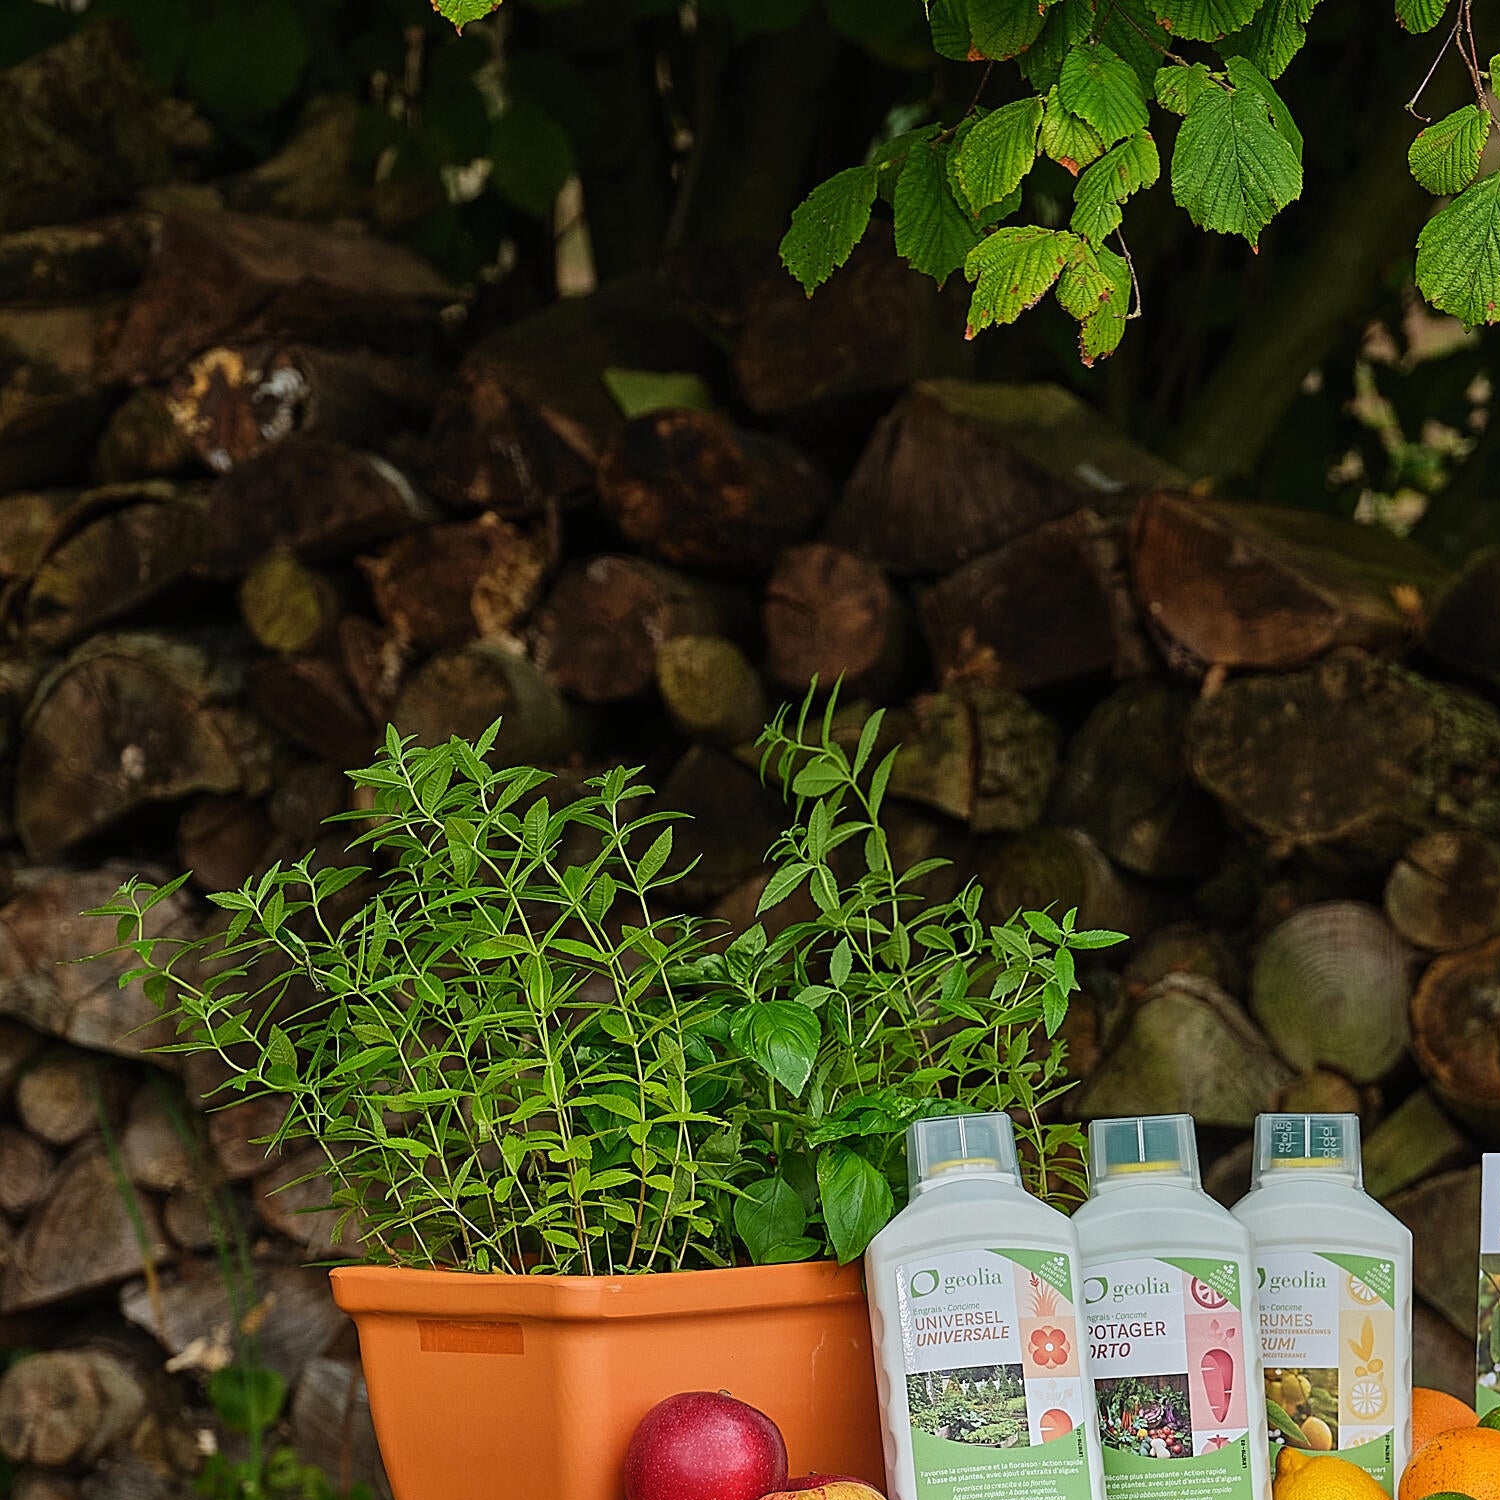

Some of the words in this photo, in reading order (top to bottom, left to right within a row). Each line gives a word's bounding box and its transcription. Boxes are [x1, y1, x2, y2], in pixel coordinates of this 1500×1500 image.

[1282, 1133, 1292, 1142] 15
[1324, 1138, 1336, 1147] 20
[1278, 1143, 1292, 1153] 25
[1324, 1149, 1336, 1158] 30
[1041, 1263, 1067, 1282] naturelle
[1046, 1260, 1067, 1276] origine
[1216, 1269, 1236, 1283] origine
[1372, 1267, 1391, 1283] origine
[944, 1268, 1002, 1294] geolia
[1039, 1269, 1064, 1288] naturale
[1208, 1278, 1232, 1296] naturale
[1210, 1272, 1236, 1290] naturelle
[1269, 1270, 1327, 1294] geolia
[1363, 1275, 1387, 1294] naturale
[1367, 1270, 1391, 1291] naturelle
[1113, 1277, 1169, 1302] geolia
[913, 1306, 942, 1316] Engrais
[948, 1302, 980, 1311] Concime
[1115, 1312, 1147, 1320] Concime
[1271, 1303, 1302, 1311] Concime
[915, 1311, 1003, 1331] UNIVERSEL
[1260, 1314, 1313, 1327] RUMES
[916, 1326, 1010, 1347] UNIVERSALE
[920, 1469, 948, 1479] Favorise
[948, 1468, 955, 1477] la
[956, 1465, 992, 1477] croissance
[992, 1463, 1001, 1474] et
[1001, 1463, 1009, 1473] la
[1008, 1461, 1038, 1473] floraison
[1042, 1459, 1063, 1470] Action
[1063, 1457, 1083, 1467] rapide
